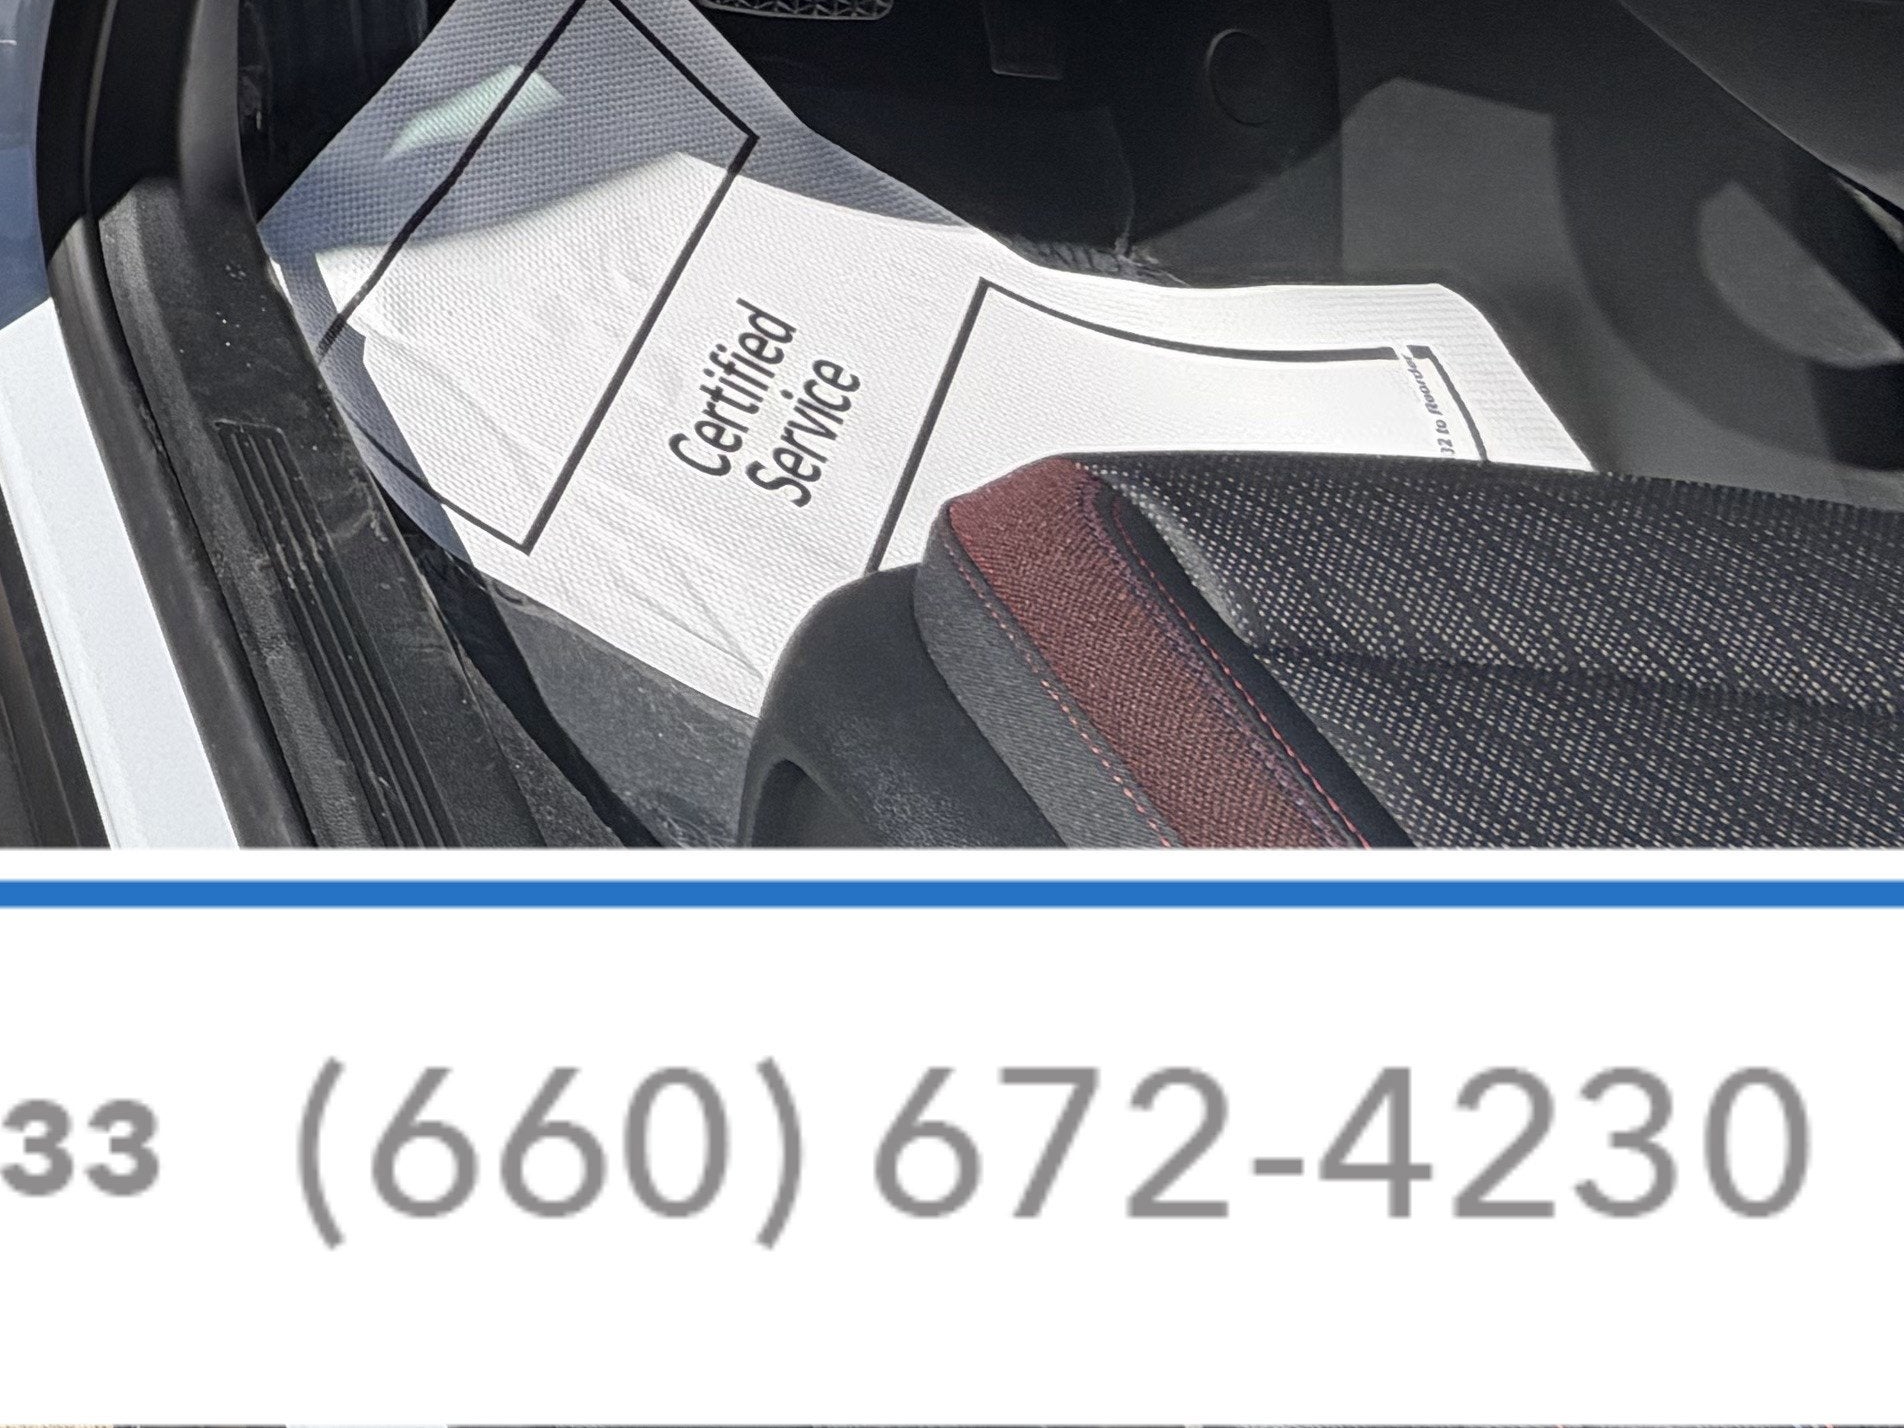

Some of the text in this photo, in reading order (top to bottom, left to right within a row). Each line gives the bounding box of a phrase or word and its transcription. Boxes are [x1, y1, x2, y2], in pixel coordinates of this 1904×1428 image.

[668, 297, 797, 477] Certified
[745, 359, 861, 508] Service
[1435, 419, 1450, 435] to
